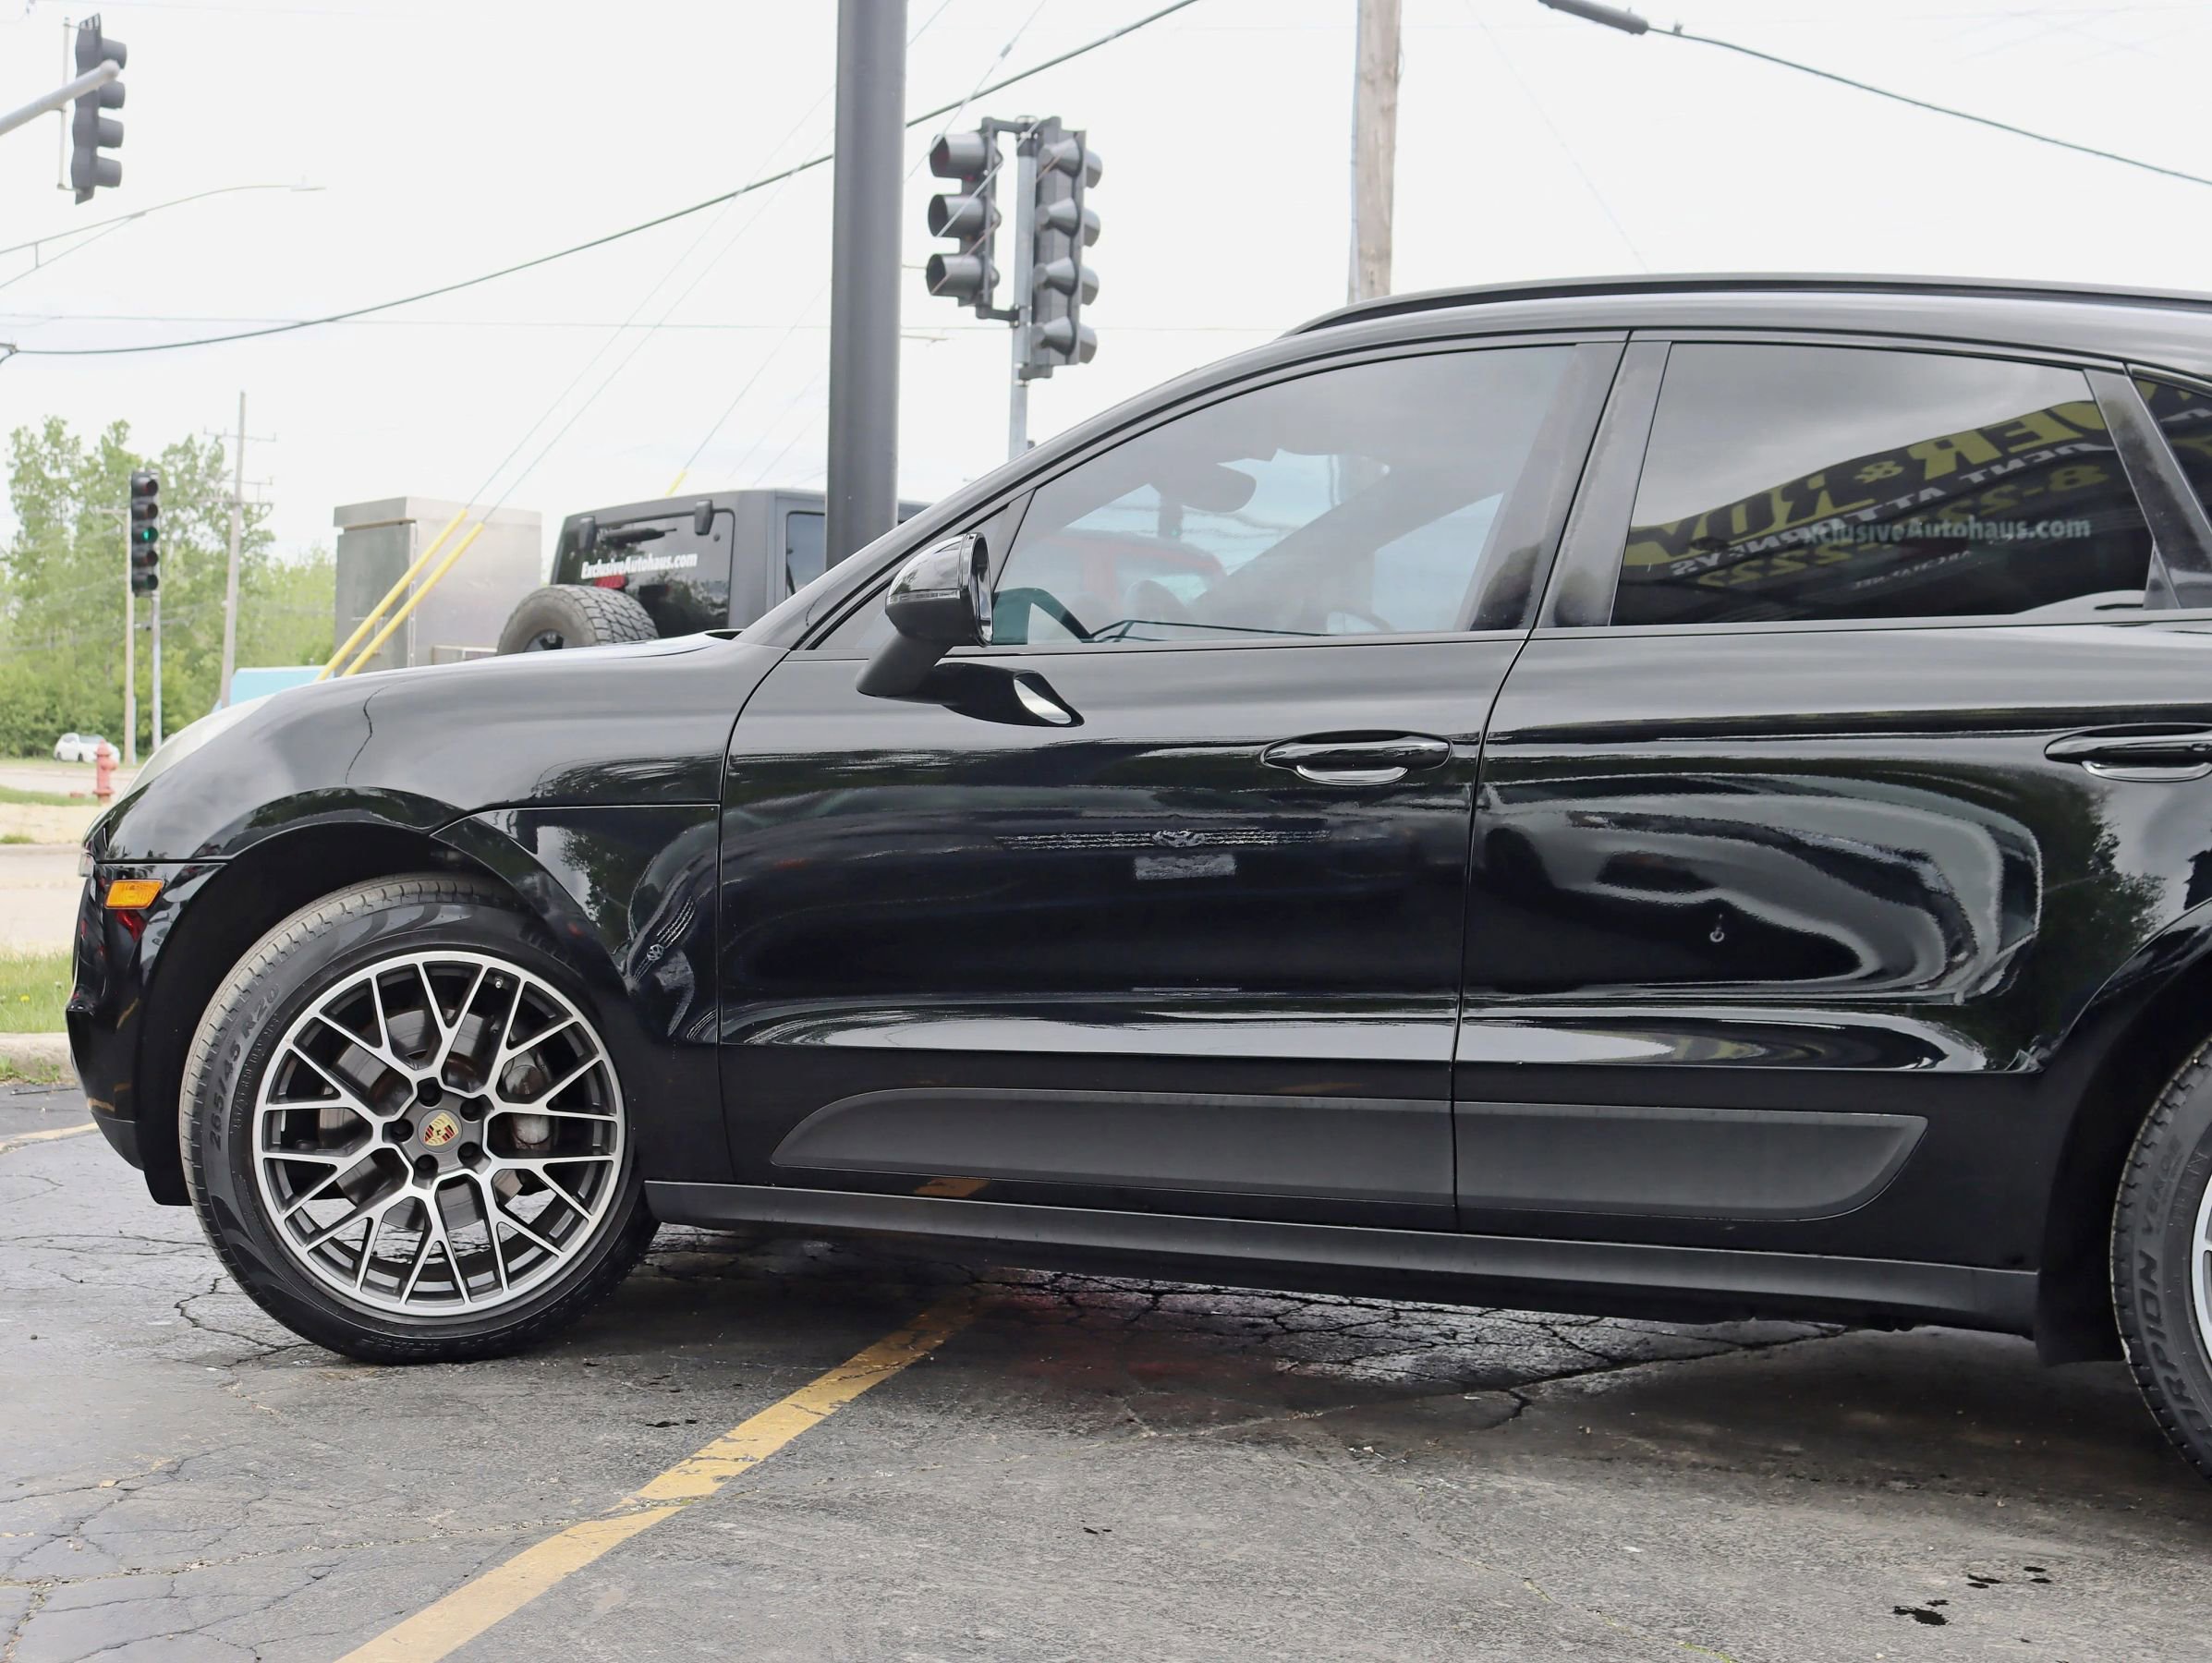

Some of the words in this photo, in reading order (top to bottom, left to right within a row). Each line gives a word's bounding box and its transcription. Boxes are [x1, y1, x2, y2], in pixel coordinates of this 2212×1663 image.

[1794, 515, 2091, 545] xclusiveAutohaus.com
[580, 553, 698, 579] ExclusiveAutohaus.com
[209, 1042, 241, 1151] 265/45
